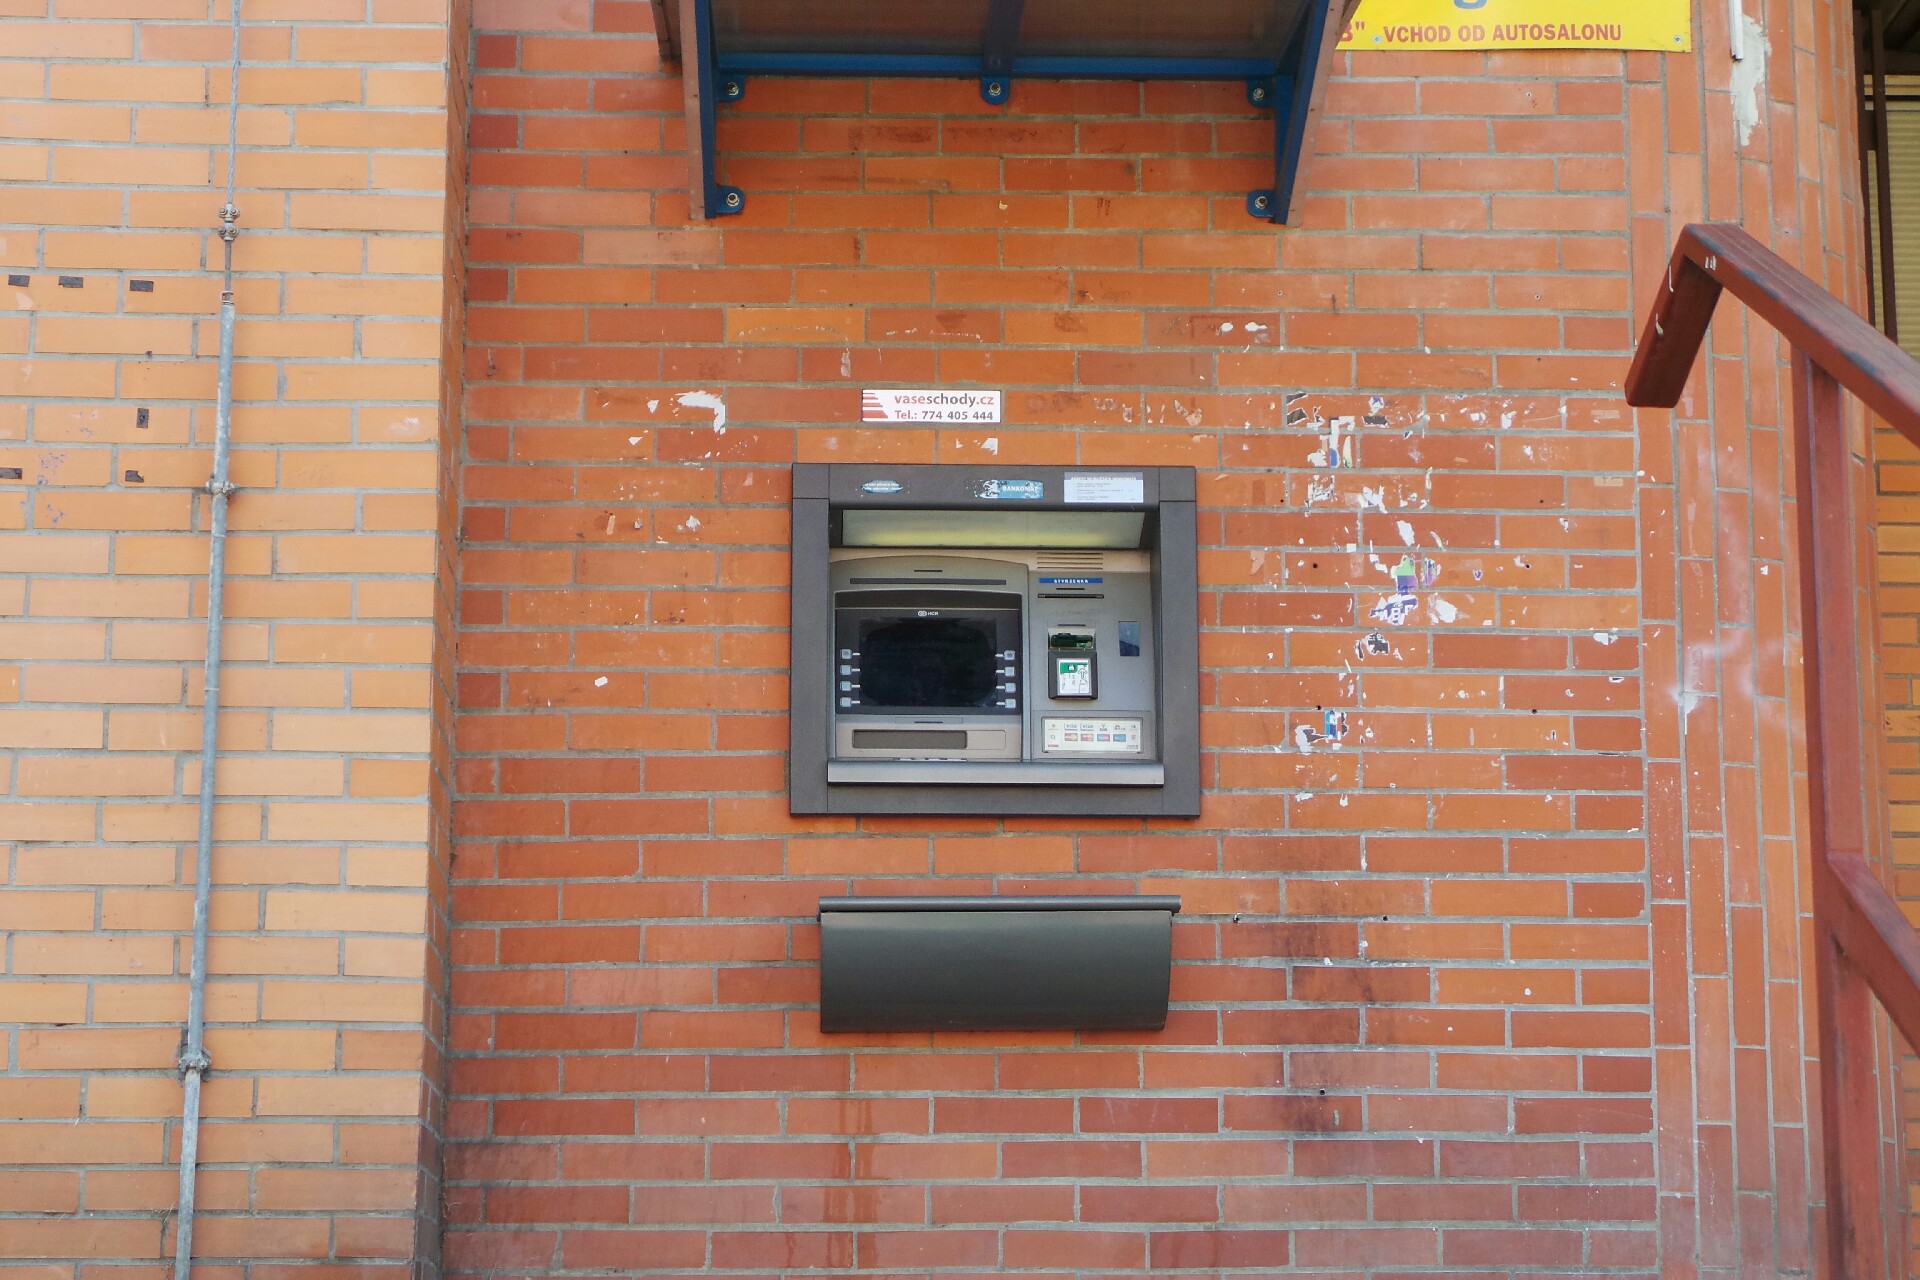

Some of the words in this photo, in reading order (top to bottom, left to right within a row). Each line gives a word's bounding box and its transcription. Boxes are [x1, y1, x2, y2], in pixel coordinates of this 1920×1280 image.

[1383, 25, 1451, 43] VCHOD
[1458, 25, 1486, 42] OD
[1492, 24, 1622, 41] AUTOSALONU
[894, 392, 995, 408] vaseschody.cz
[894, 410, 918, 420] Tel.:
[921, 410, 943, 420] 774
[947, 411, 968, 420] 405
[972, 411, 993, 420] 444
